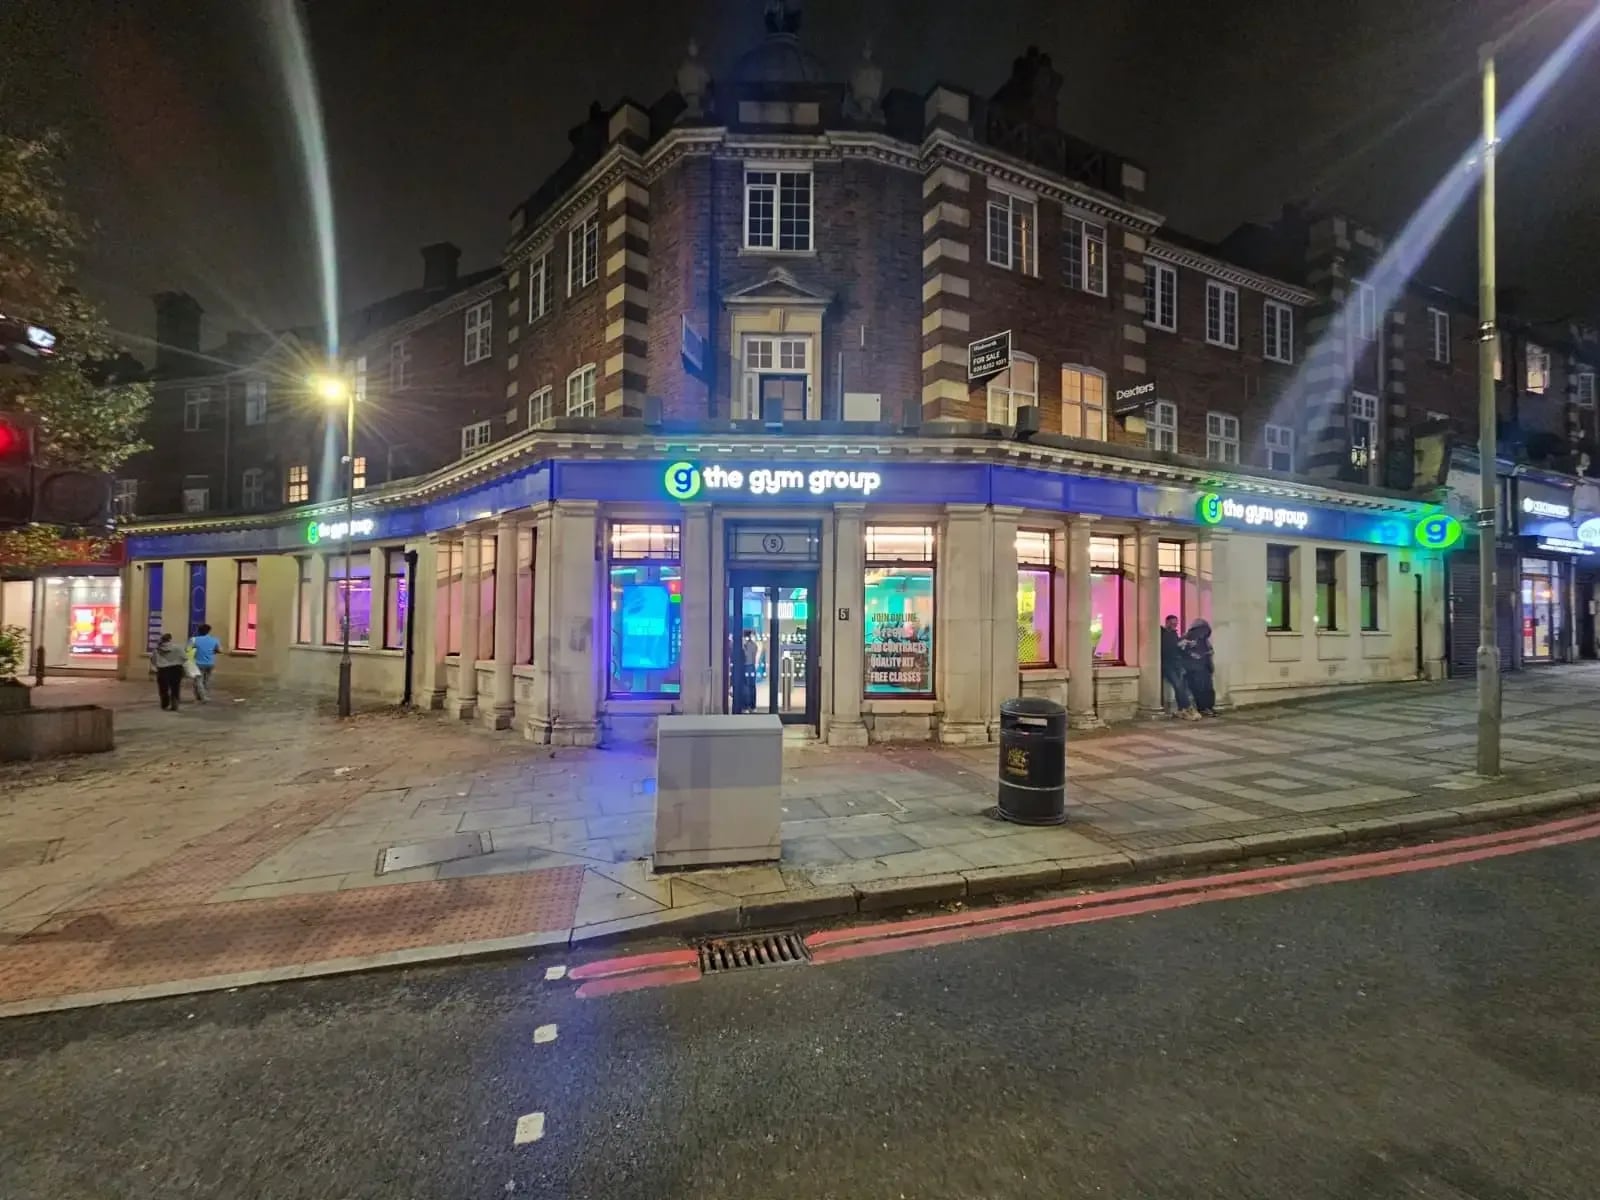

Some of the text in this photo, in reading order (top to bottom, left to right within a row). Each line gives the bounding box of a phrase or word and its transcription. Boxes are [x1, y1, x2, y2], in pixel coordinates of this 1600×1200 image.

[973, 351, 1000, 365] FOR SALE
[1116, 383, 1154, 400] Dexters
[702, 465, 743, 488] the
[749, 469, 804, 494] gym
[809, 469, 880, 495] group
[1223, 498, 1244, 518] the
[1245, 505, 1273, 525] gym
[1273, 508, 1308, 530] group
[770, 539, 777, 549] 5
[872, 613, 889, 622] JOIN
[871, 655, 901, 667] QUALITY
[871, 671, 921, 682] FREE CLASSES
